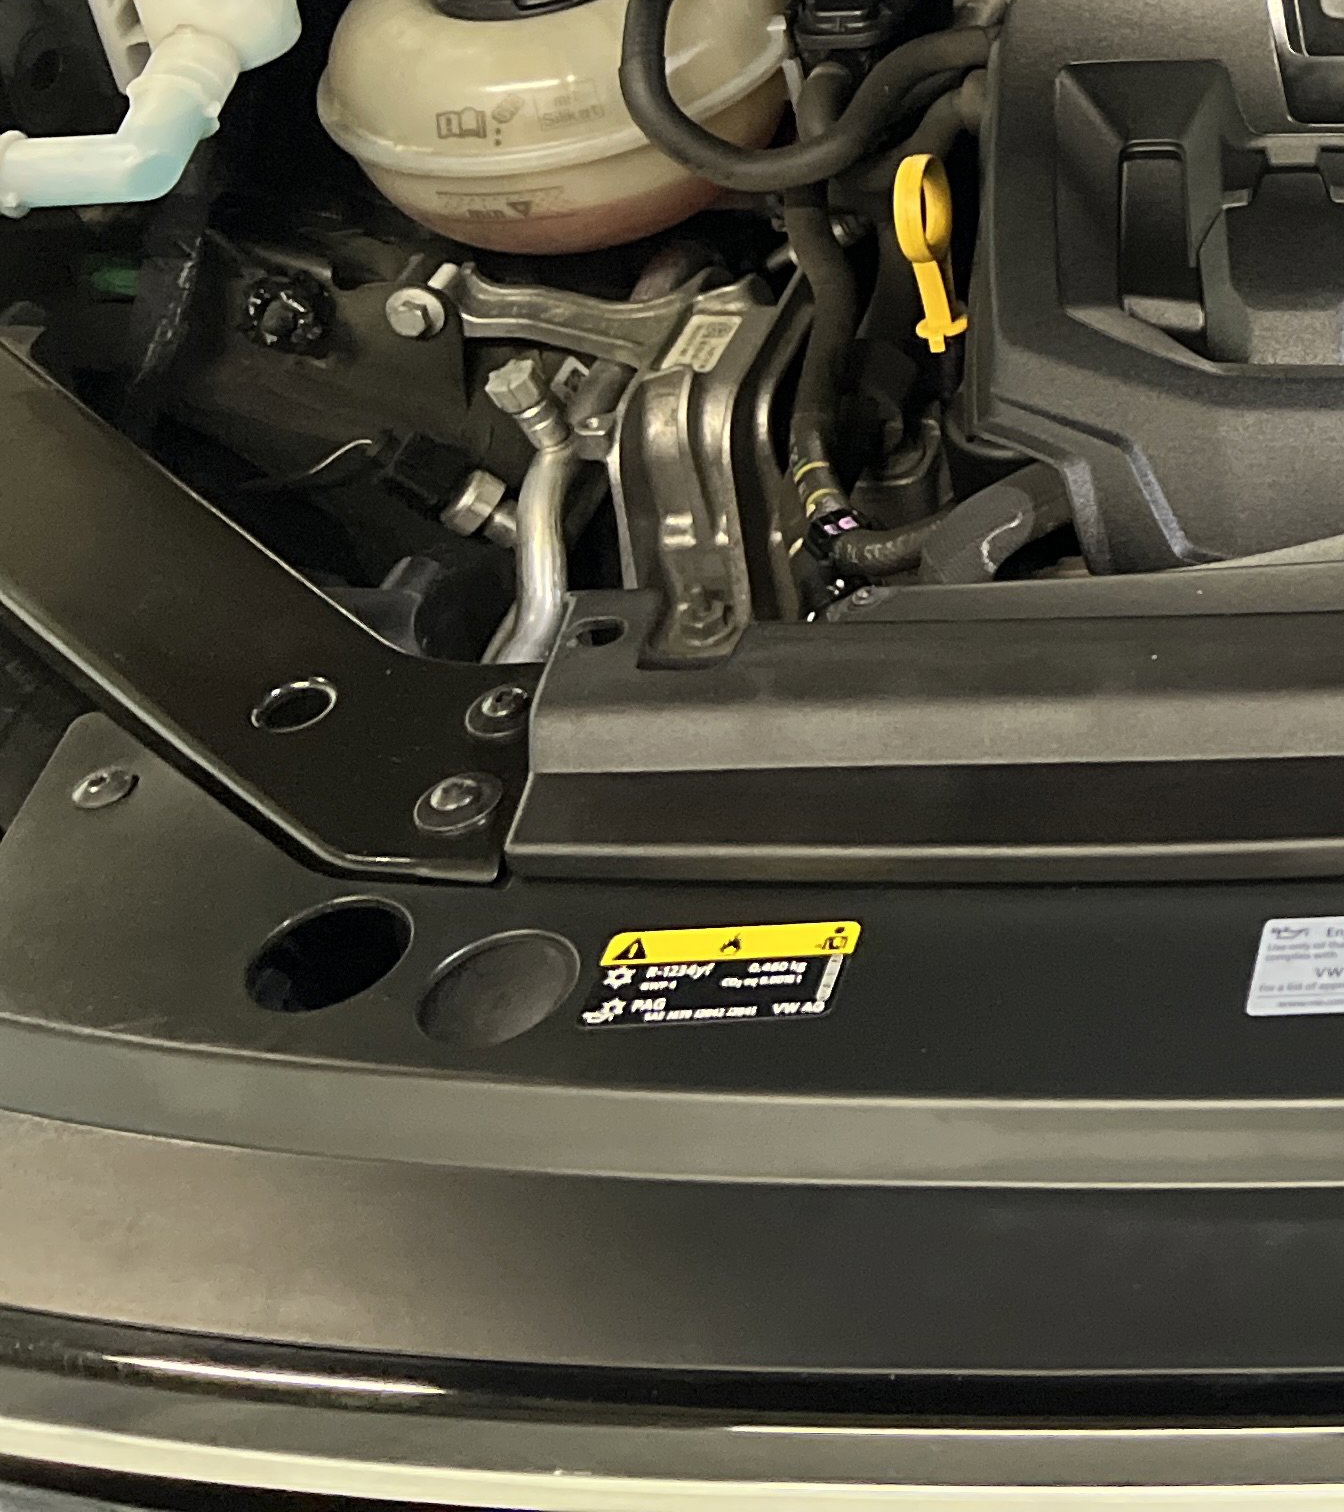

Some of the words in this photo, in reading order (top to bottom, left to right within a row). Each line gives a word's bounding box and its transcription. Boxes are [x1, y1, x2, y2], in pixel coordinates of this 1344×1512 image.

[1314, 966, 1344, 978] VW
[631, 997, 667, 1013] PAG
[771, 1001, 801, 1015] VW
[800, 1001, 826, 1014] AG
